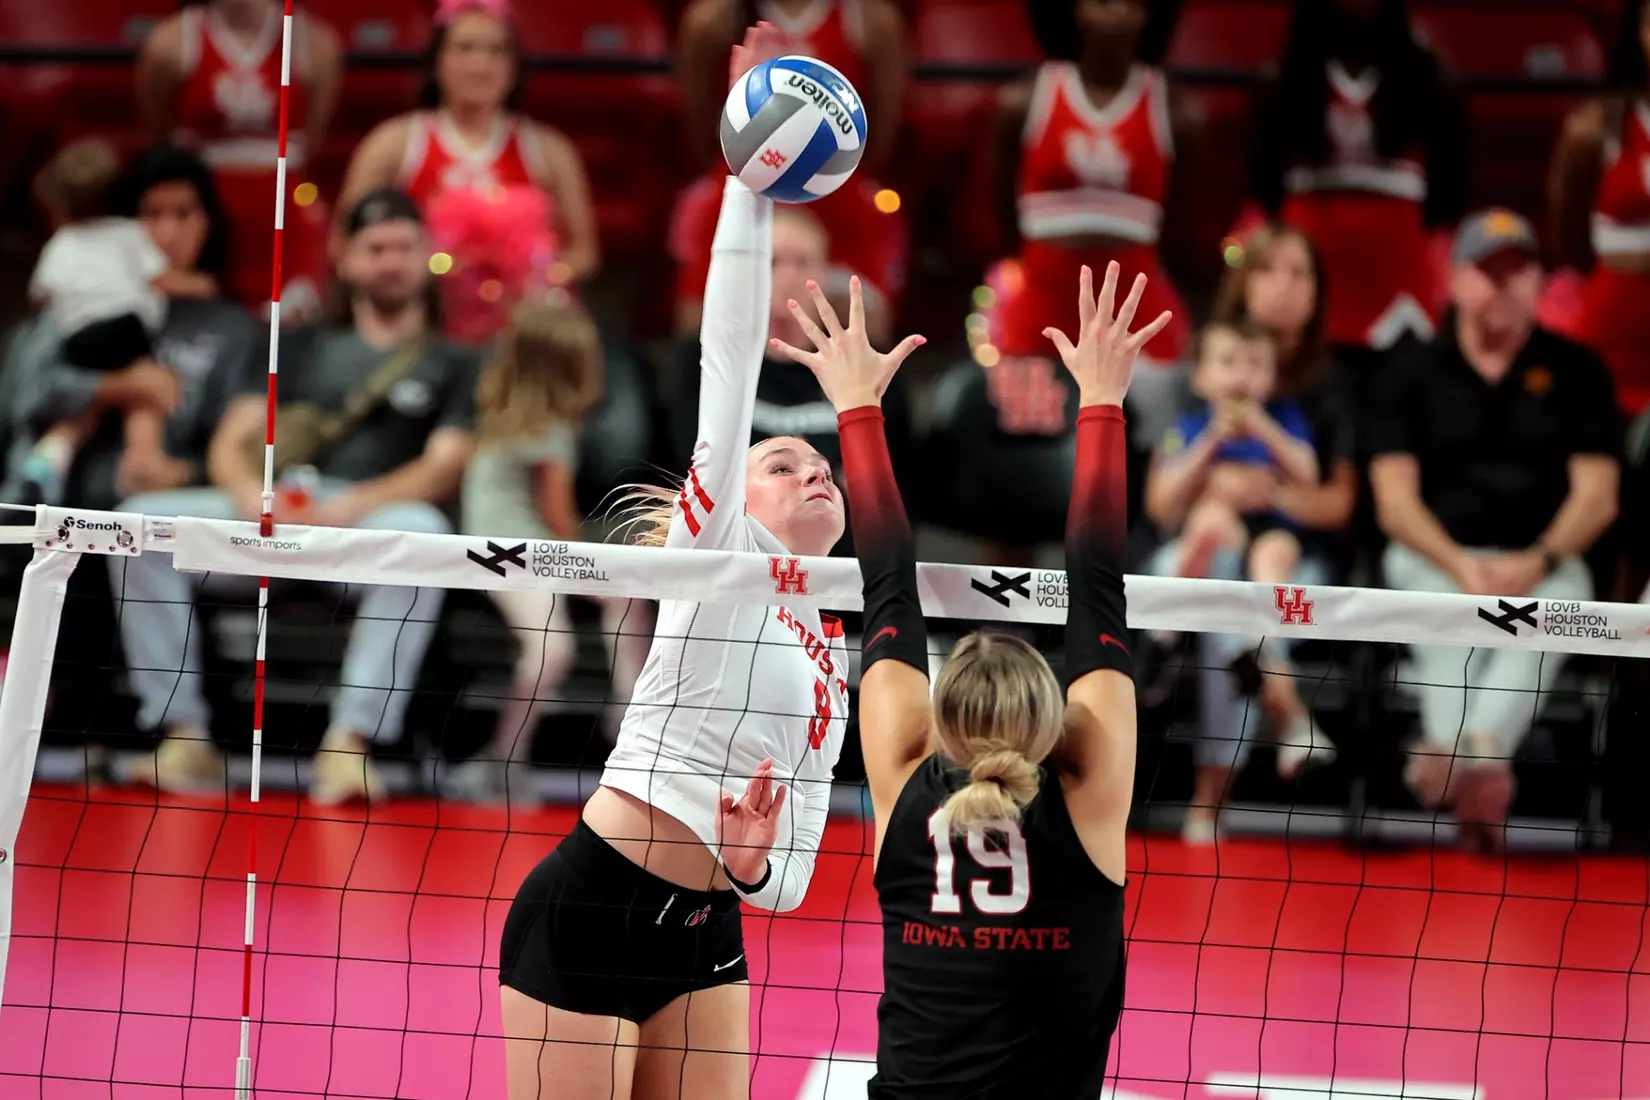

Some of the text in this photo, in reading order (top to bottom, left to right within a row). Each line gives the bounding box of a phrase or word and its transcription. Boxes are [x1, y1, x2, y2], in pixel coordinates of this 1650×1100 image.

[788, 74, 853, 135] molten
[76, 519, 122, 531] Senoh
[230, 535, 302, 551] sports imports
[532, 554, 595, 568] HOUSTON
[532, 566, 610, 581] VOLLEYBALL
[768, 556, 809, 595] UH
[1273, 586, 1315, 626] UH
[1545, 613, 1607, 626] HOUSTON
[1544, 625, 1622, 640] VOLLEYBALL
[928, 806, 1032, 916] 19
[903, 920, 1071, 950] IOWA STATE
